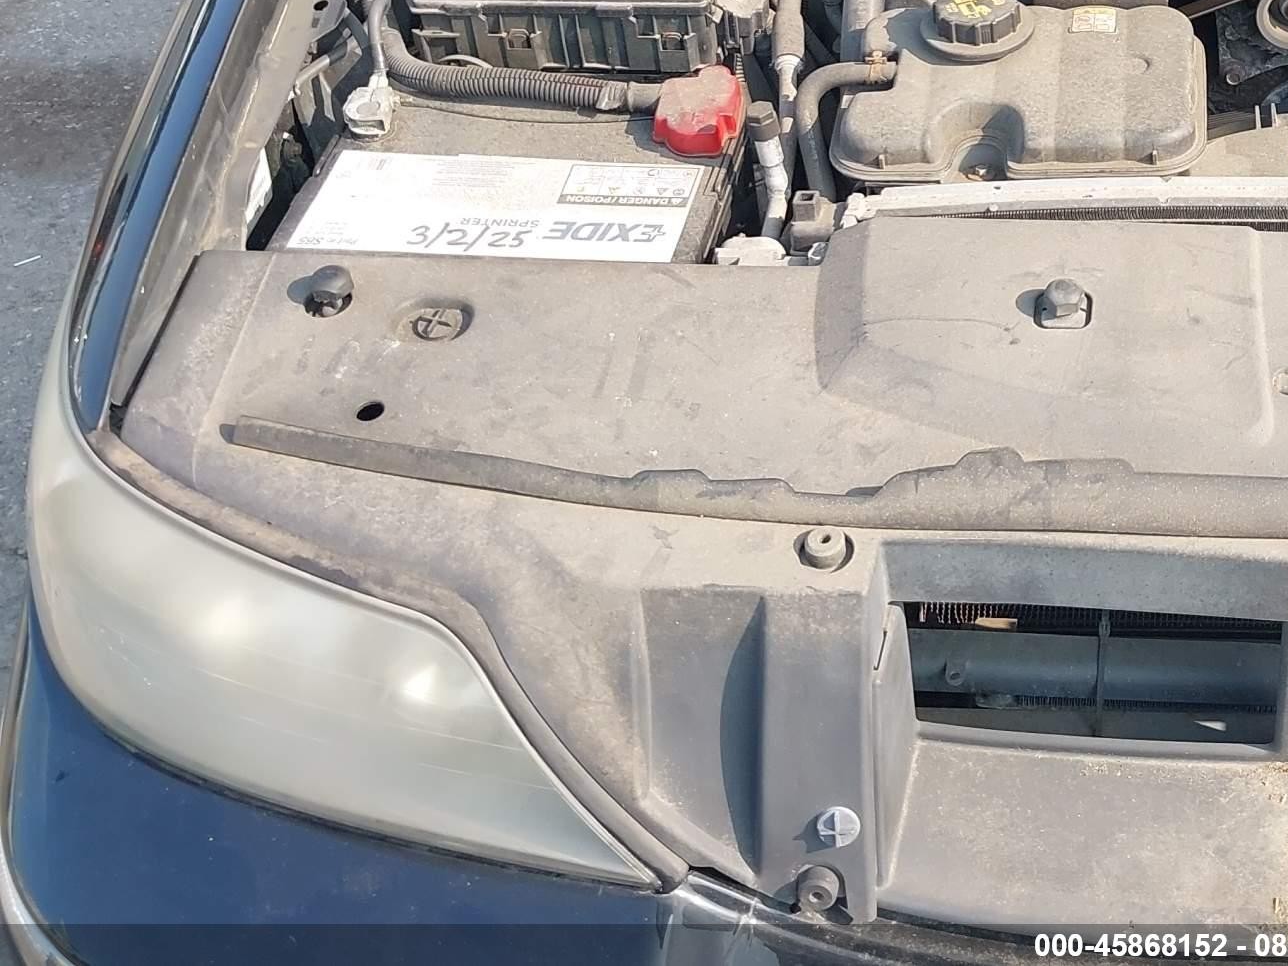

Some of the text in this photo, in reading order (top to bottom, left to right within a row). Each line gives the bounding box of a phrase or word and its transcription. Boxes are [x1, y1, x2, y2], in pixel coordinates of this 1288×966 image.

[565, 194, 610, 203] POISON
[617, 195, 668, 205] DANGER
[406, 222, 533, 251] 3/2/25
[460, 218, 667, 242] EXIDE SPRINTER
